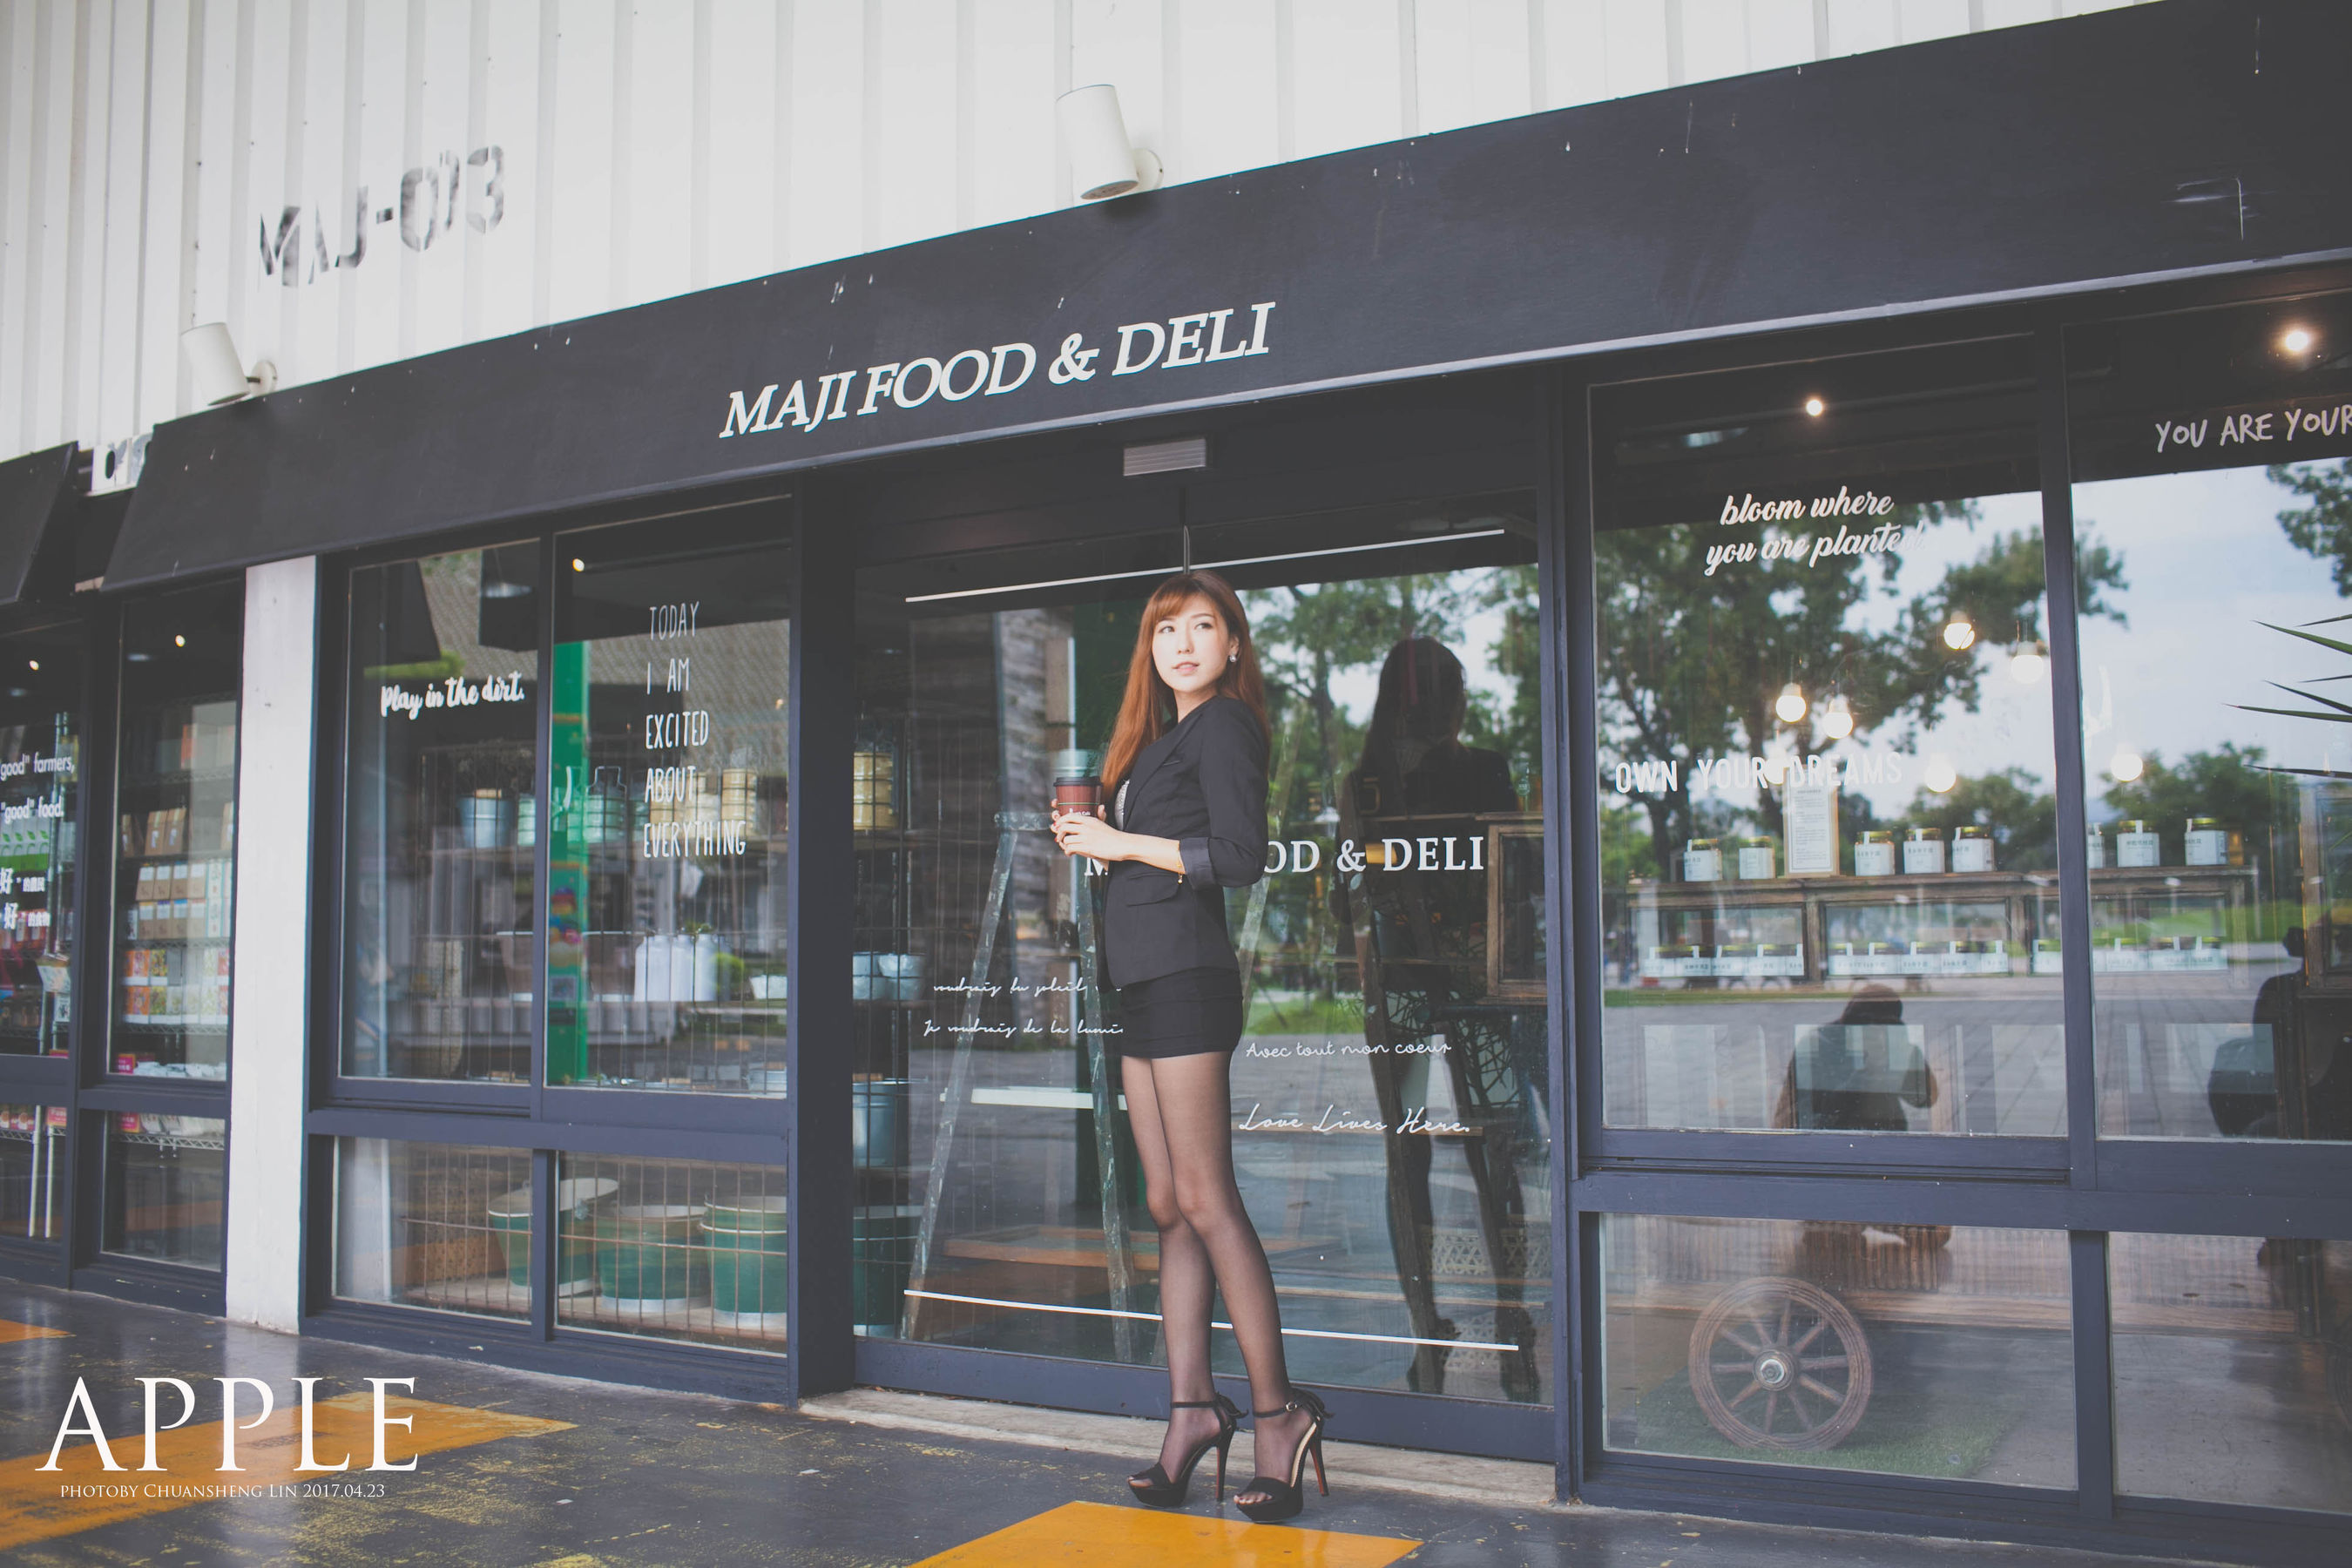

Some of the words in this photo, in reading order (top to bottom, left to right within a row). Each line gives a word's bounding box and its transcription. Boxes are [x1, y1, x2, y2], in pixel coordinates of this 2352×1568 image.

[719, 370, 856, 439] MAJI
[857, 342, 1037, 416] FOOD
[1048, 333, 1099, 385] &
[1112, 301, 1276, 376] DELI
[2155, 419, 2208, 453] YOU
[2220, 413, 2274, 446] ARE
[2284, 404, 2352, 442] YOUR
[1720, 493, 1807, 525] bloom
[1809, 485, 1895, 517] where
[1703, 542, 1758, 577] you
[1761, 537, 1811, 559] are
[1808, 520, 1926, 568] planted
[650, 601, 700, 641] TODAY
[425, 683, 445, 708] in
[444, 676, 480, 708] the
[481, 670, 525, 702] dirt.
[646, 662, 652, 695] I
[666, 658, 691, 693] AM
[645, 710, 710, 750] EXCITED
[33, 751, 76, 774] farmers,
[1614, 760, 1680, 794] OWN
[1697, 756, 1768, 791] YOUR
[1789, 752, 1903, 787] DREAMS
[645, 766, 697, 803] ABOUT
[37, 795, 65, 819] food.
[643, 820, 747, 859] EVERYTHING
[1264, 840, 1321, 874] OD
[1336, 839, 1367, 873] &
[1382, 836, 1484, 871] DELI
[1245, 1042, 1292, 1058] Avec
[1295, 1041, 1336, 1057] tout
[1341, 1043, 1390, 1056] mon
[1238, 1103, 1304, 1132] Love
[1312, 1105, 1388, 1132] Lives
